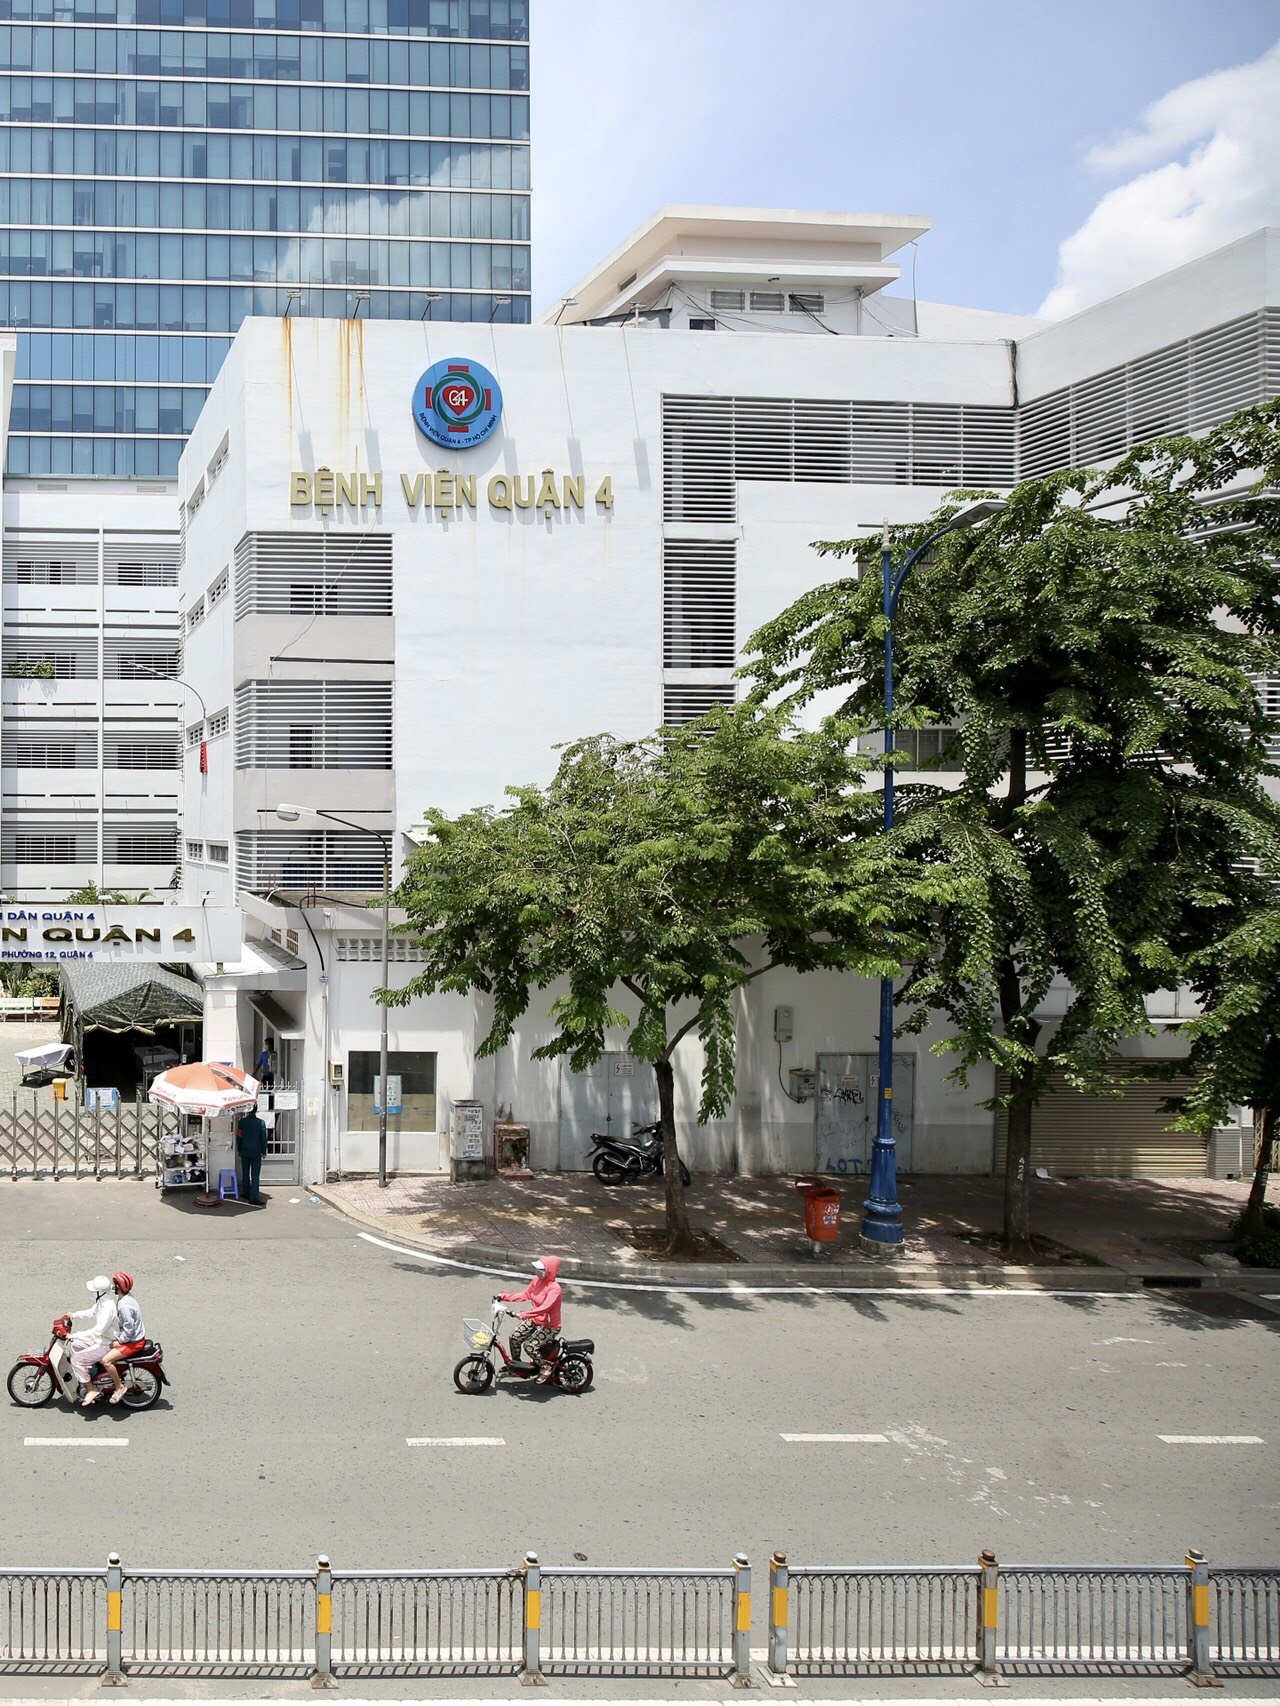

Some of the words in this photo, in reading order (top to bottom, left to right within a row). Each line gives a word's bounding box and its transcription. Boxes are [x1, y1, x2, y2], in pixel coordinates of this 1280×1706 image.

[487, 414, 497, 429] MINH
[290, 465, 382, 516] BỆNH
[400, 467, 476, 518] VIỆN
[487, 468, 585, 519] QUẬN
[595, 475, 614, 509] 4
[7, 910, 37, 920] DÂN
[42, 911, 83, 922] QUẬN
[42, 925, 160, 946] QUẬN
[172, 928, 195, 942] 4
[1, 950, 42, 958] PHƯỜNG
[45, 951, 57, 959] 12,
[59, 950, 85, 960] QUẬN
